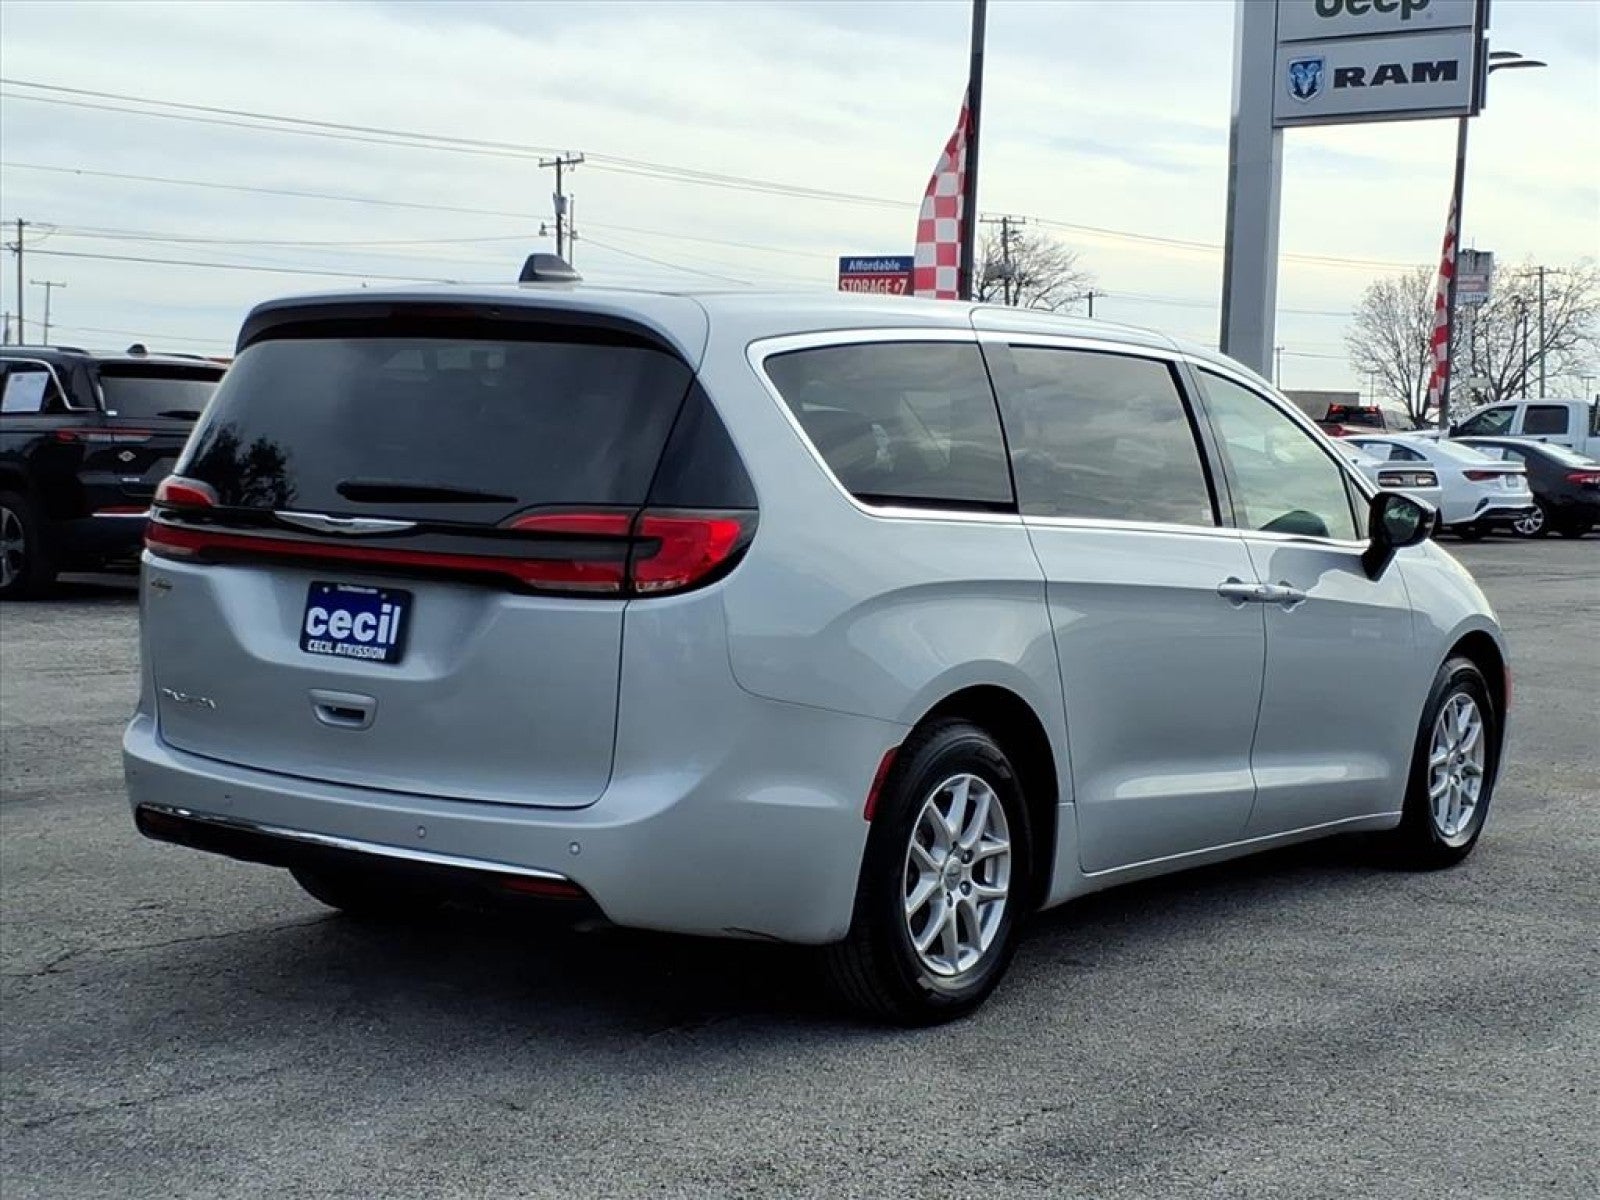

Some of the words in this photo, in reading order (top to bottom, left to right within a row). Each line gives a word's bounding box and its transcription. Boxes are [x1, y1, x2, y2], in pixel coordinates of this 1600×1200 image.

[1333, 60, 1458, 88] RAM
[849, 259, 900, 271] Affordable
[841, 278, 893, 293] STORAGE
[306, 603, 401, 644] cecil
